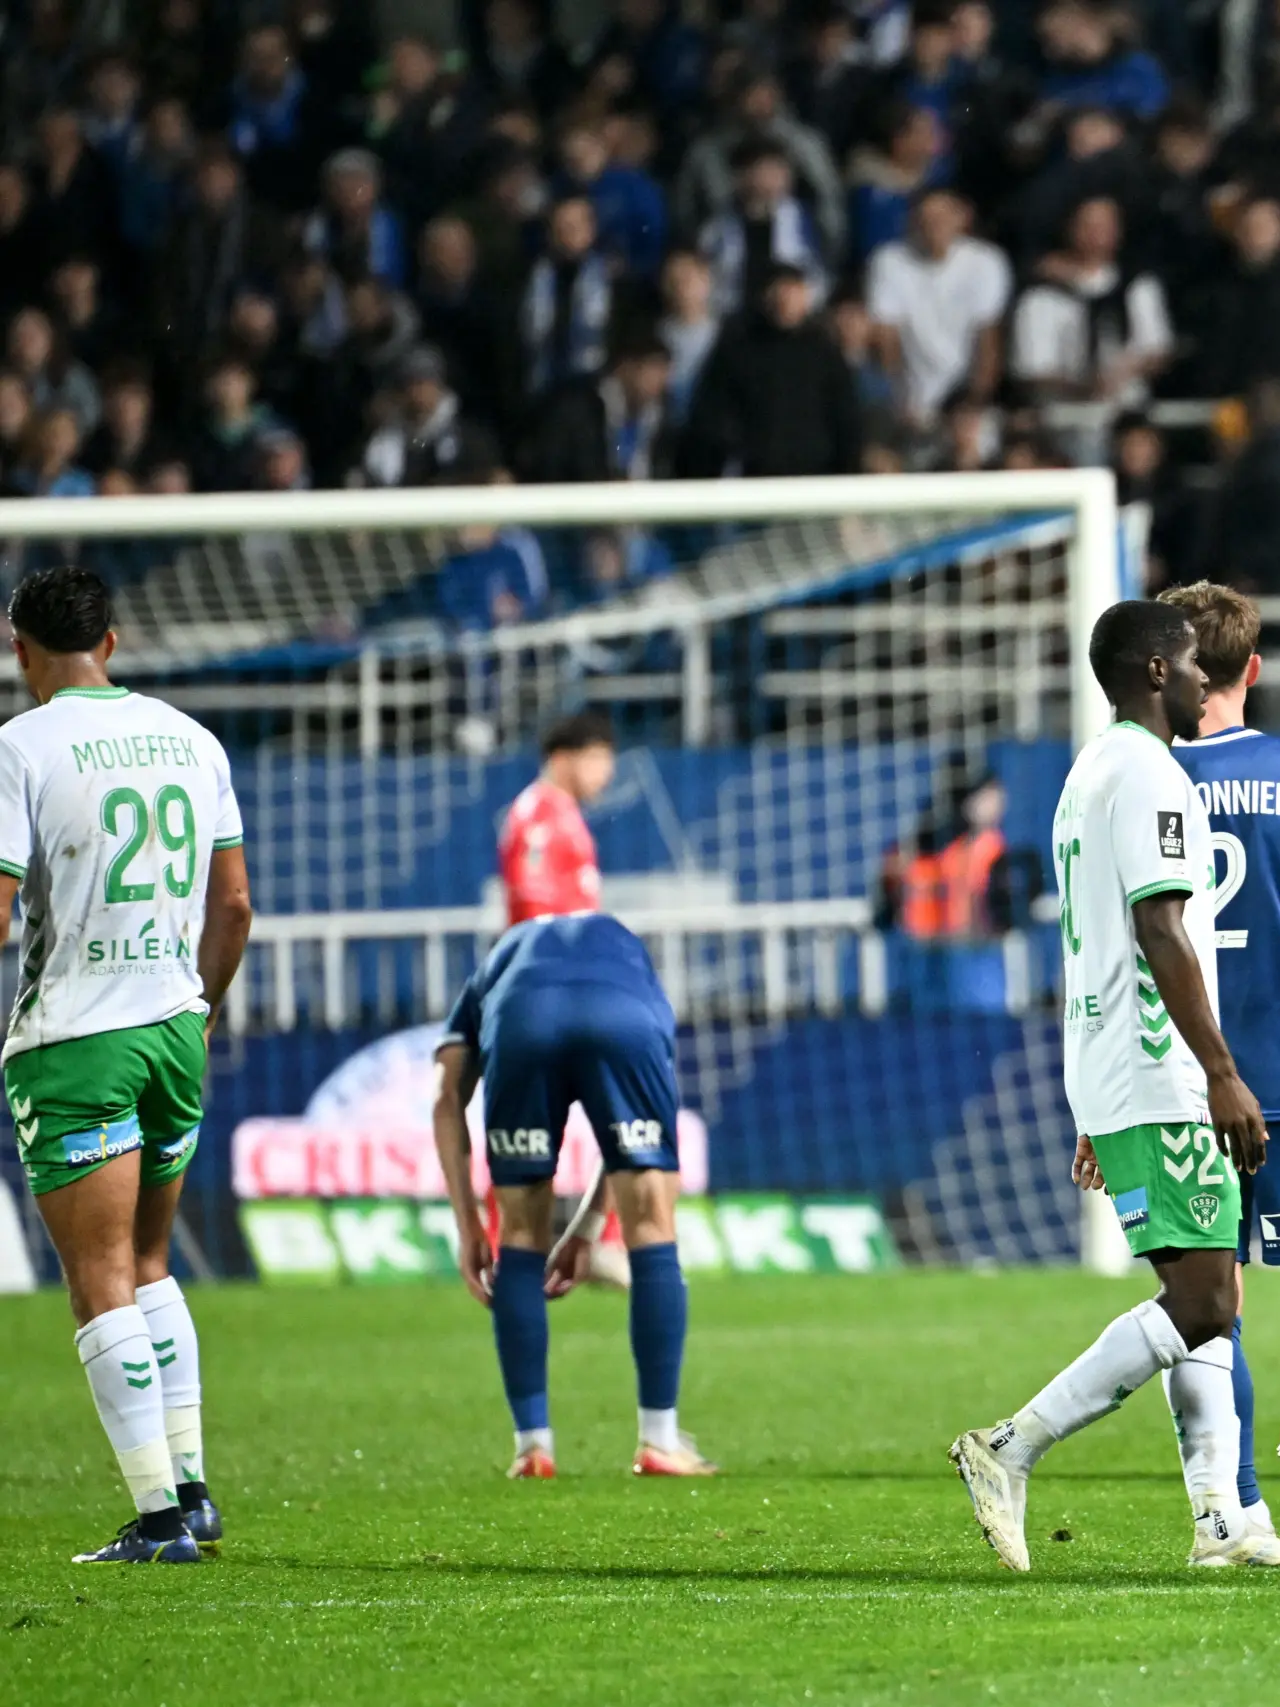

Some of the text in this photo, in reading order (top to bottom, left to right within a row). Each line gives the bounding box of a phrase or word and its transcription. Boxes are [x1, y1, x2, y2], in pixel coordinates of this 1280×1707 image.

[100, 784, 196, 904] 29
[89, 964, 157, 976] ADAPTIVE
[1193, 1198, 1216, 1207] ASSE
